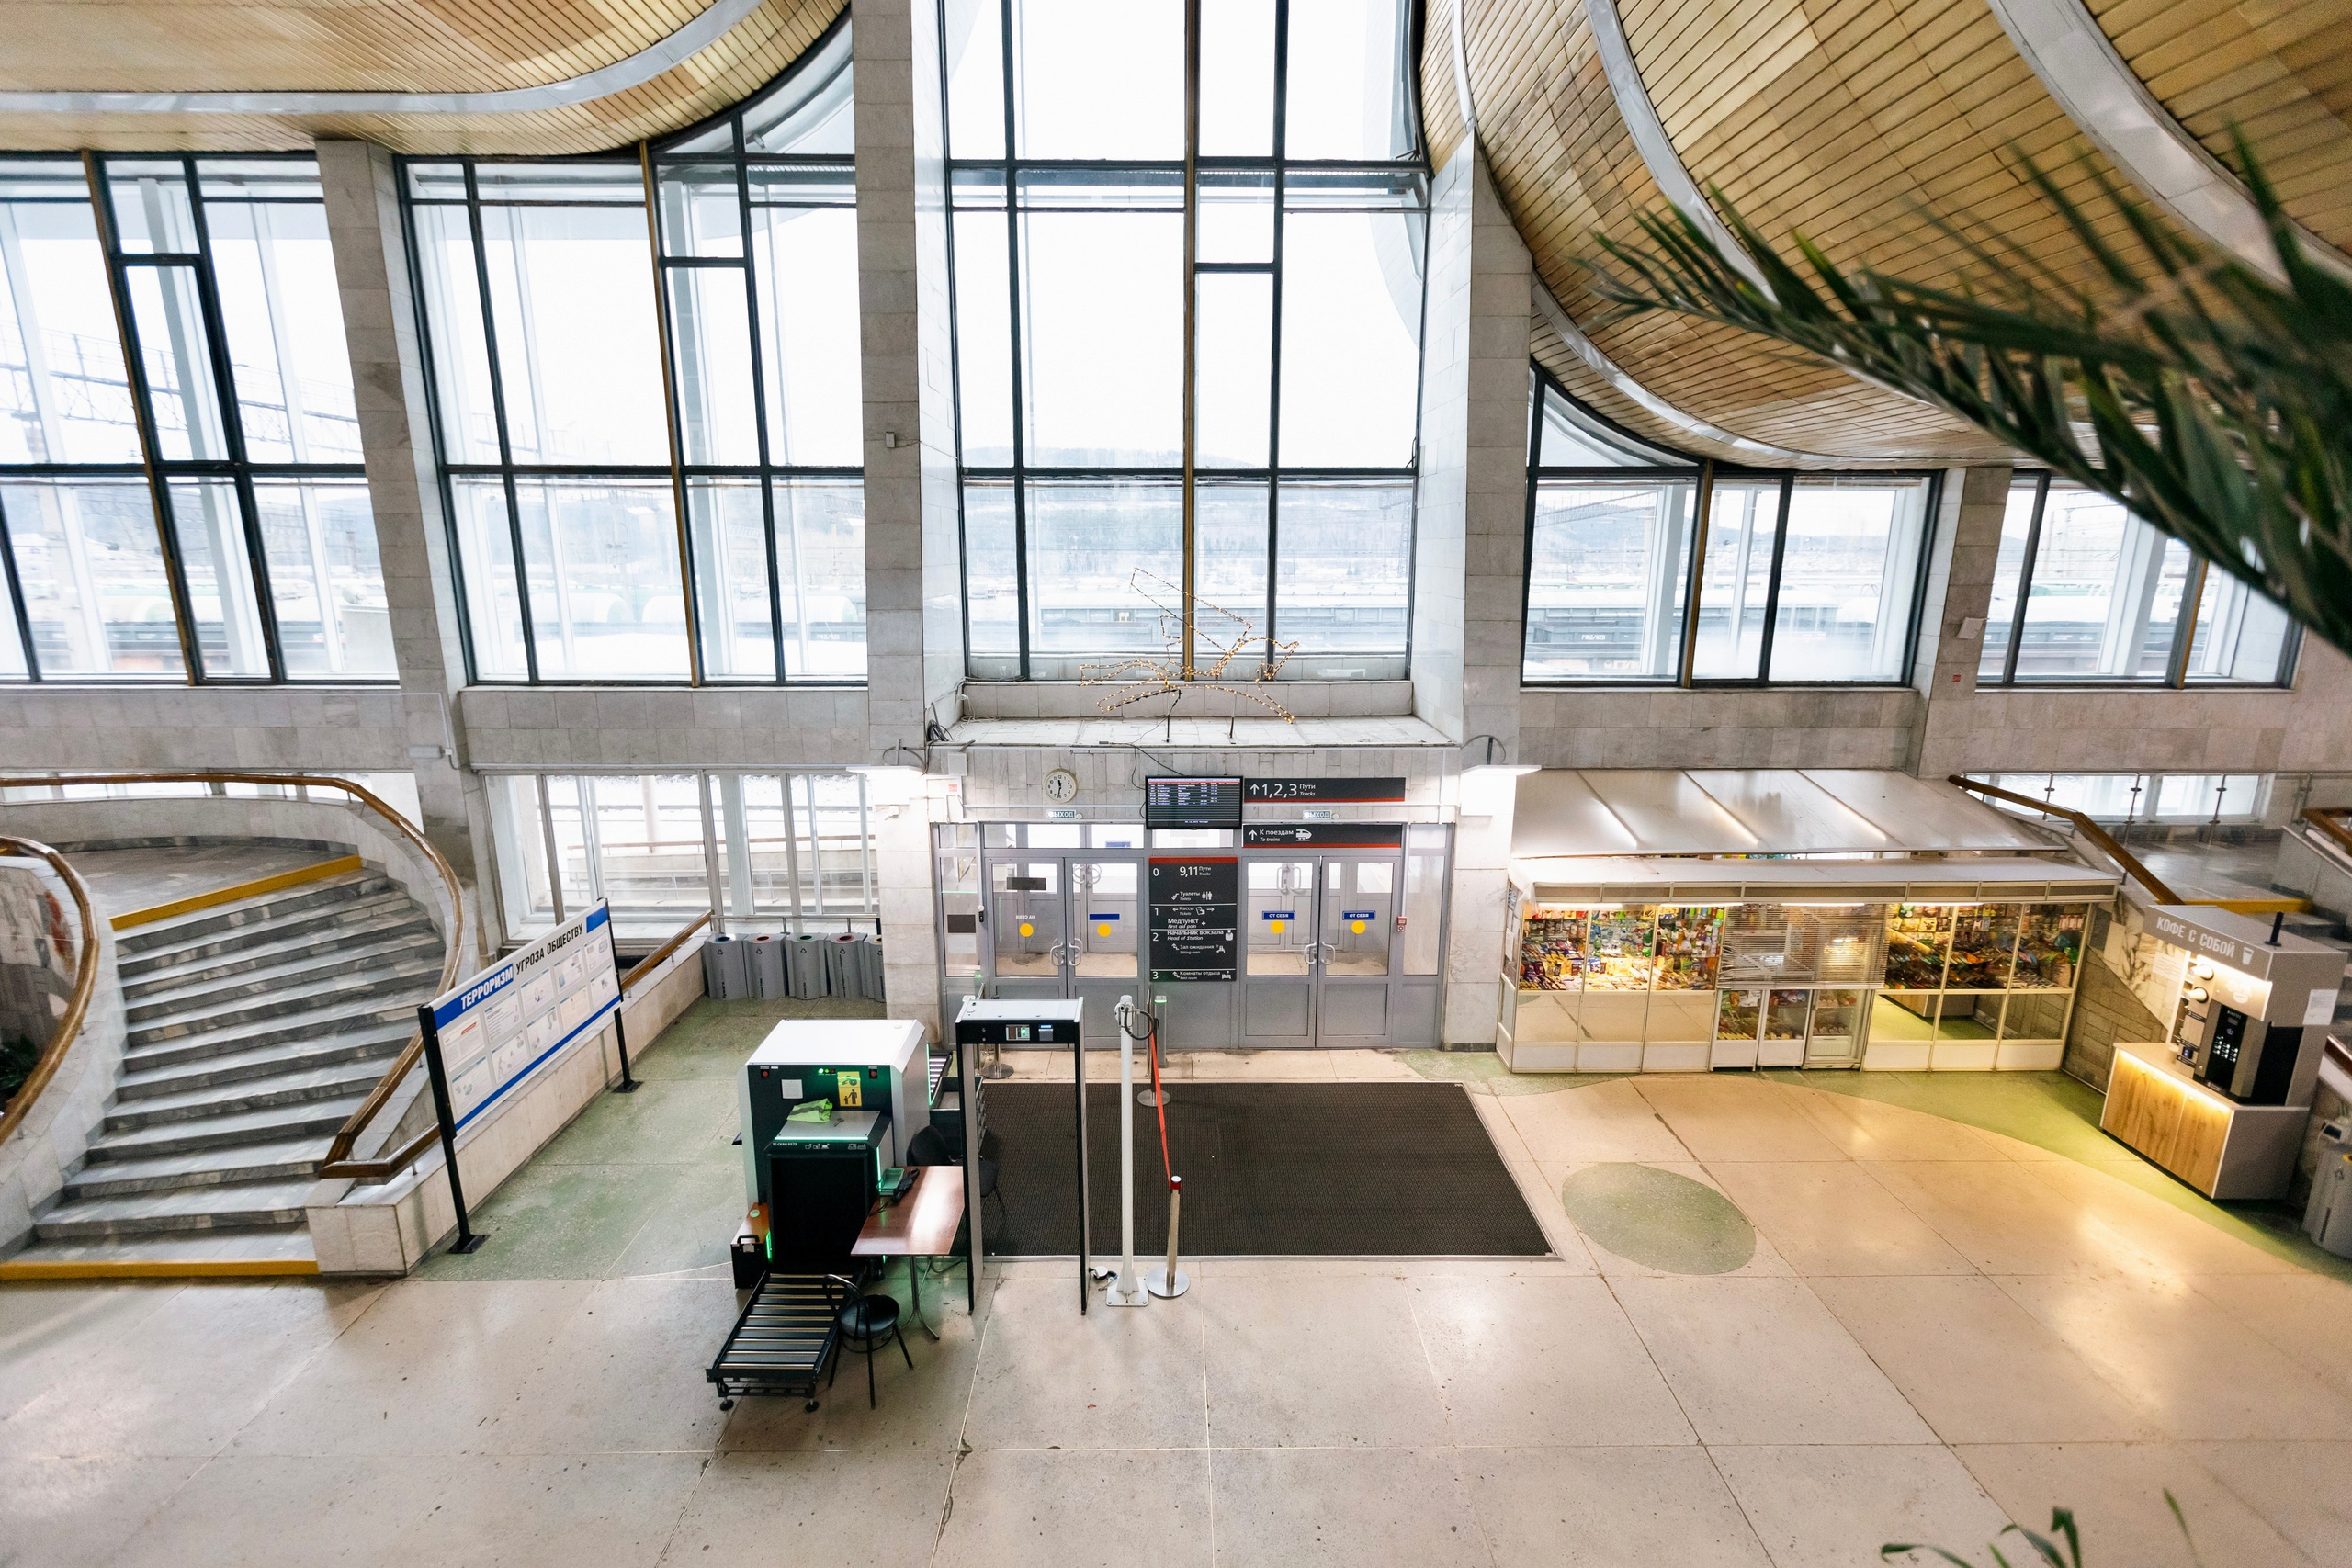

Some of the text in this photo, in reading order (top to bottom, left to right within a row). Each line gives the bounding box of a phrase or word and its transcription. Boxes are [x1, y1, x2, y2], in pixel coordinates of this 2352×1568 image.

[1261, 783, 1297, 798] 1,2,3
[1152, 868, 1159, 876] 0
[1179, 866, 1198, 877] 9,11
[1154, 908, 1159, 916] 1
[1152, 932, 1159, 942] 2
[2156, 916, 2235, 958] КОФЕ С СОБОЙ
[460, 923, 583, 1010] ТЕРРОРИЗМ УГРОЗА ОБЩЕСТВУ
[1152, 971, 1159, 979] 3
